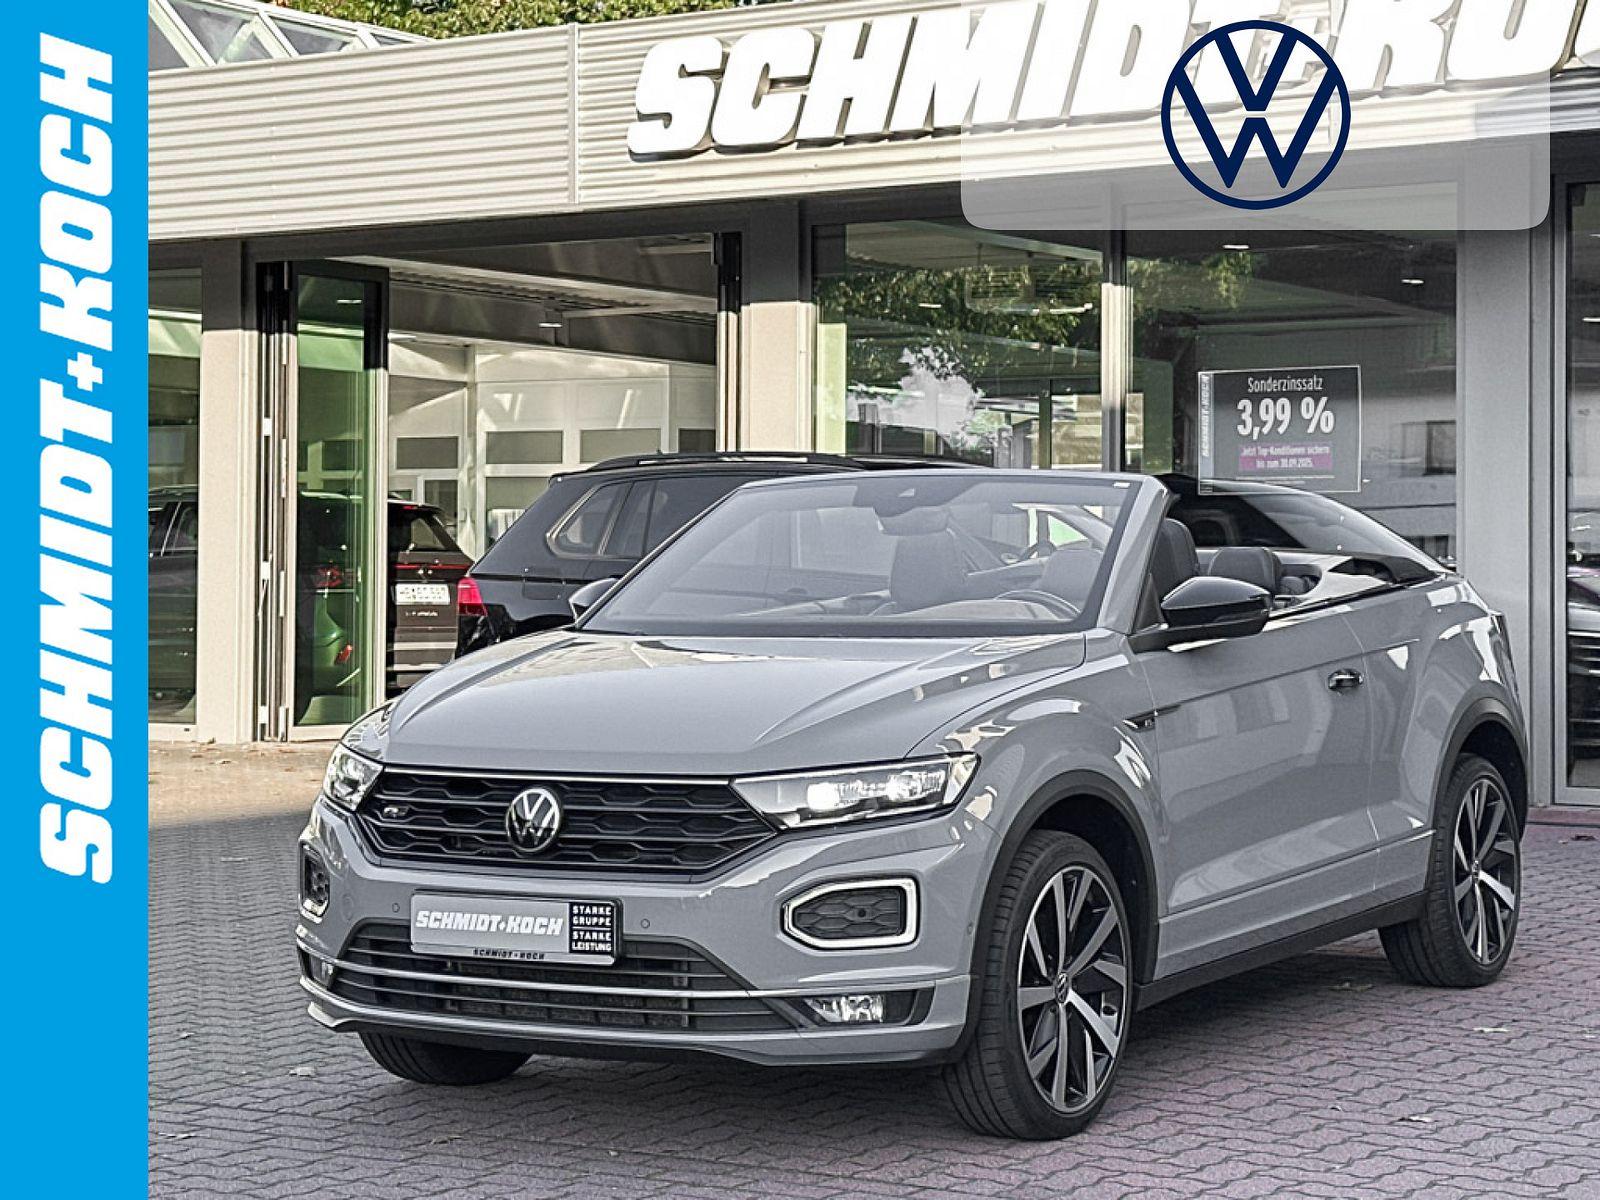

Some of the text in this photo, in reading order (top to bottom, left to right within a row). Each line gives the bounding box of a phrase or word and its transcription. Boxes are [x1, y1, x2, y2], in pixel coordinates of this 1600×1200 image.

[1247, 375, 1323, 393] Sonderzinssatz
[1236, 396, 1335, 441] 3,99 %
[572, 905, 612, 915] STARKE
[415, 910, 564, 936] SCHMIDT+KOCH
[572, 915, 612, 926] GRUPPE
[572, 931, 612, 941] STARKE
[571, 941, 612, 951] LEISTUNG
